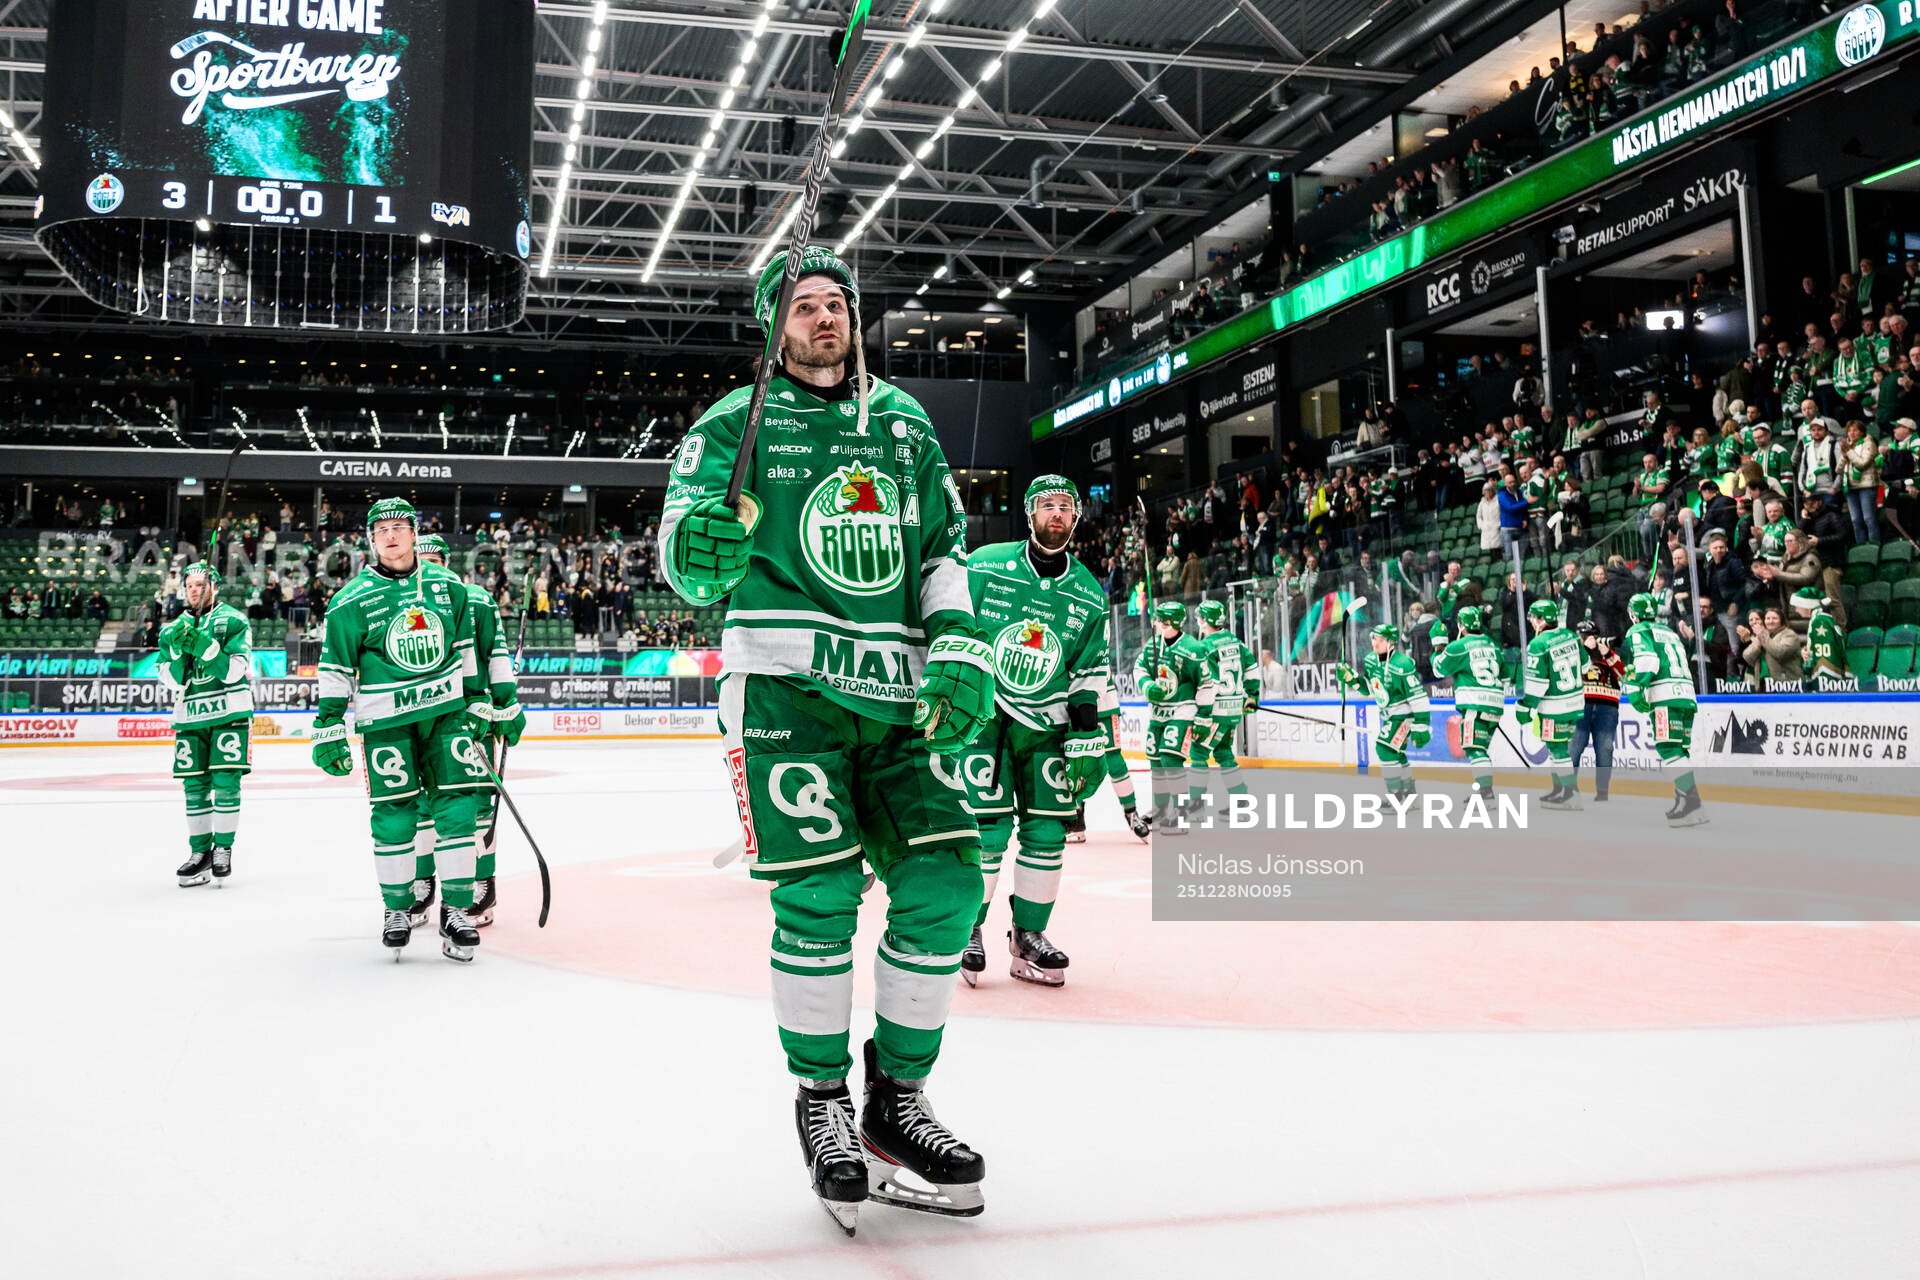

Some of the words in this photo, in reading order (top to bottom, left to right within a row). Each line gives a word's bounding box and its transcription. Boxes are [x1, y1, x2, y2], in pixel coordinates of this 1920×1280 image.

[192, 0, 290, 27] AFTER
[297, 0, 385, 35] GAME
[170, 42, 401, 125] Sportbaren
[1612, 120, 1658, 165] NÄSTA
[1658, 71, 1768, 143] HEMMAMATCH
[1770, 46, 1807, 91] 10/1
[162, 181, 187, 209] 3
[237, 185, 323, 217] 00.0
[374, 196, 397, 224] 1
[1577, 203, 1671, 255] RETAILSUPPORT
[1427, 273, 1461, 309] RCC
[1250, 363, 1276, 388] STENA
[1132, 423, 1151, 443] SEB
[768, 444, 813, 454] MARCON
[840, 445, 884, 458] liljedahl
[319, 460, 392, 477] CATENA
[396, 462, 452, 478] Arena
[767, 464, 796, 479] akea
[901, 493, 921, 527] A
[819, 518, 900, 554] RÖGLE
[397, 633, 439, 652] RÖGLE
[930, 638, 994, 669] BAUE
[1814, 643, 1831, 658] 30
[25, 652, 70, 676] VÅRT
[74, 658, 113, 676] RBK
[528, 652, 568, 674] VÅRT
[1003, 646, 1051, 675] RÖGLE
[185, 699, 227, 718] MAXI
[556, 715, 598, 726] ER-HO
[624, 713, 657, 727] Dekor
[669, 713, 704, 728] Design
[1774, 723, 1909, 740] BETONGBORRNING
[744, 727, 792, 740] BAUER
[1775, 743, 1784, 755] &
[1792, 738, 1874, 760] SÅGNING
[1882, 744, 1907, 760] AB
